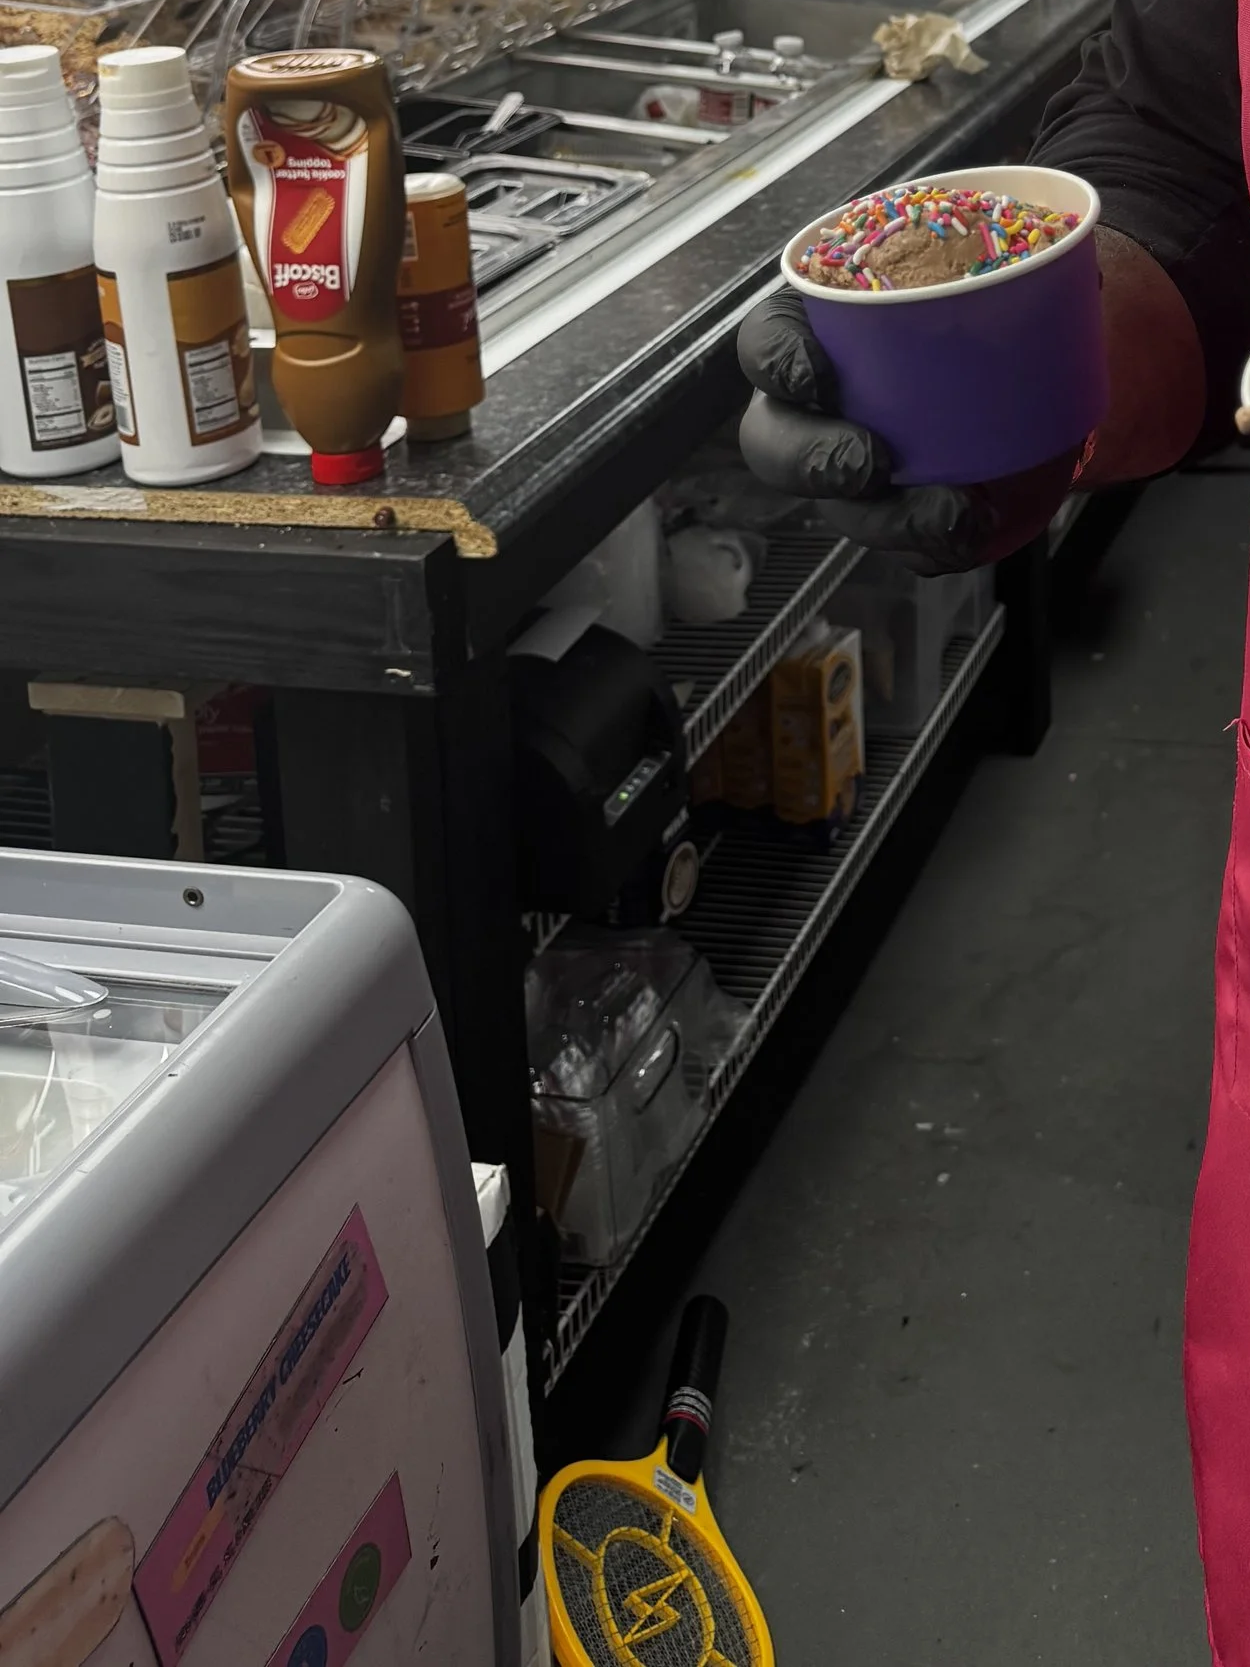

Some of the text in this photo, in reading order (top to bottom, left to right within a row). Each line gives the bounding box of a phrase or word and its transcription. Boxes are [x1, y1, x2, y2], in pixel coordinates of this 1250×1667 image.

[287, 157, 332, 169] topping
[275, 168, 310, 181] butter
[273, 262, 341, 291] Biscoff
[205, 1384, 278, 1510] BLUEBERRY
[279, 1251, 352, 1386] CHEESECAKE
